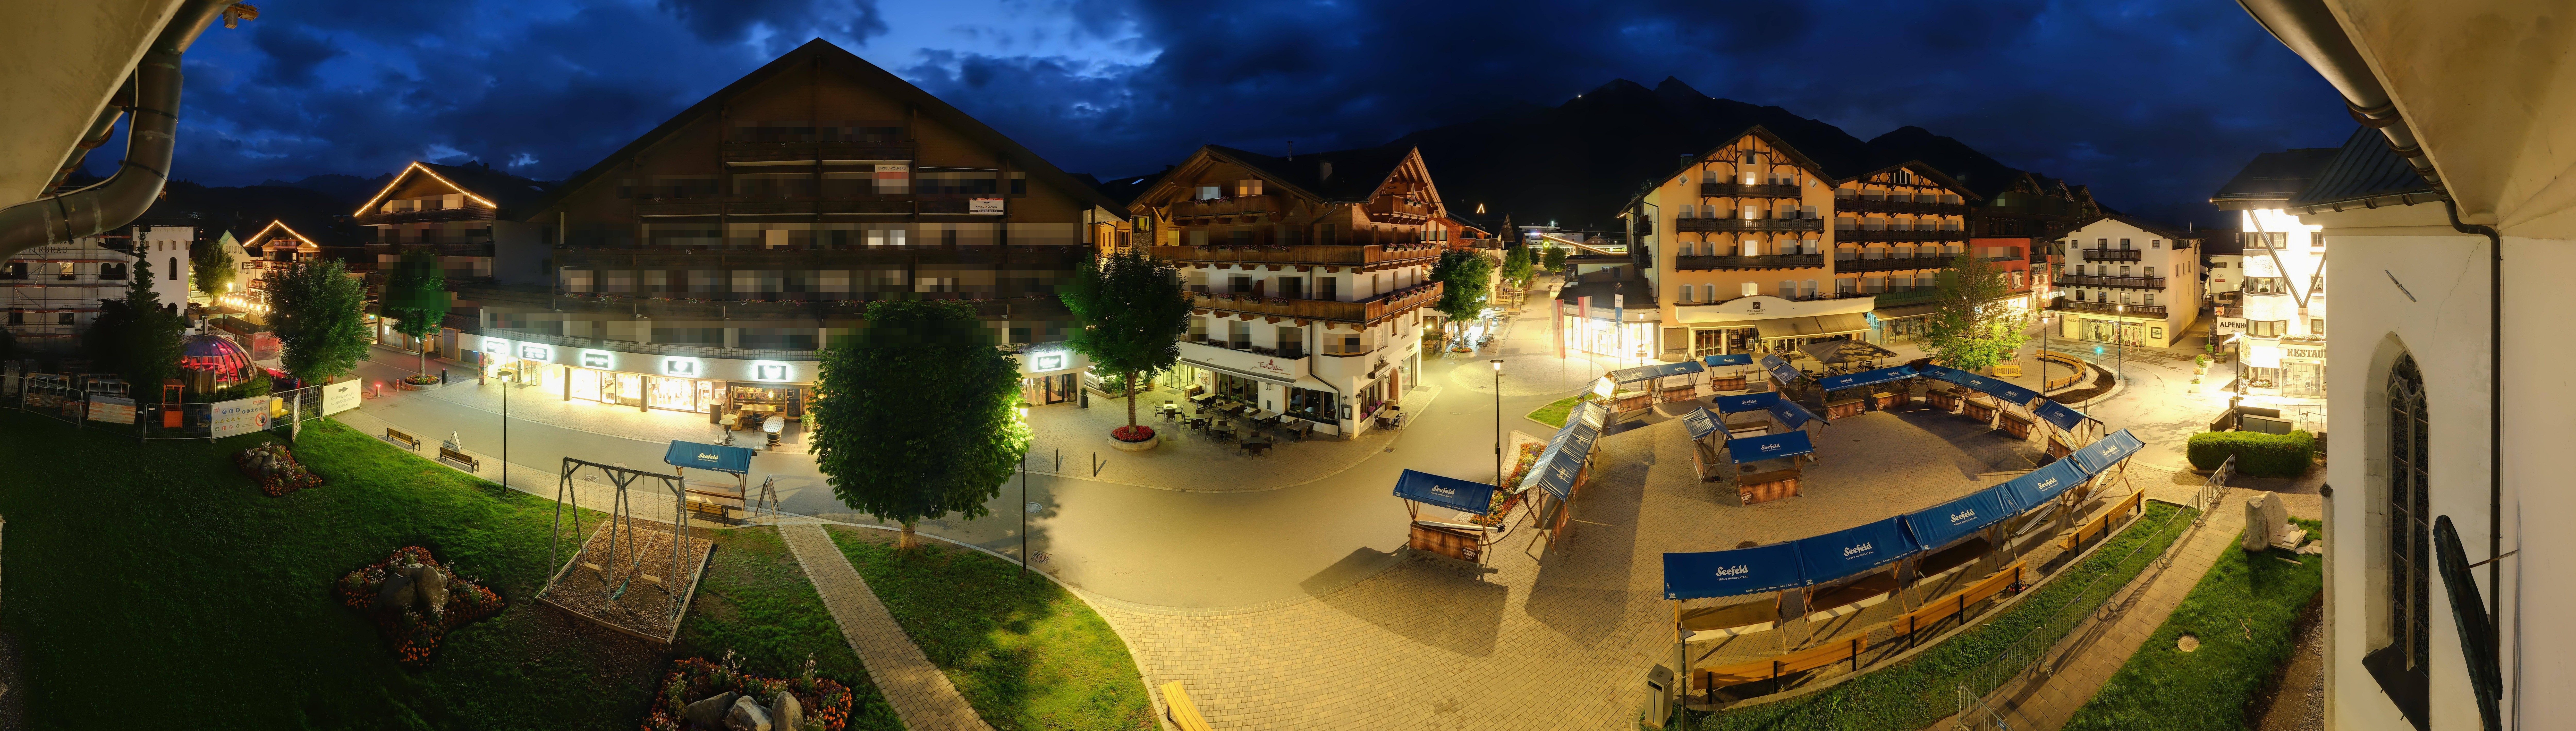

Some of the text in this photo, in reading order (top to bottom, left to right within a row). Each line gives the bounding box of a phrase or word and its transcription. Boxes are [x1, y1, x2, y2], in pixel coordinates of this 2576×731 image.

[1406, 343, 1414, 351] SAILER
[2287, 348, 2326, 358] RESTAU
[1375, 364, 1390, 377] RESTAURANT
[331, 397, 354, 405] KONGRESSZENTRUM
[2103, 445, 2118, 455] Seefeld
[2038, 477, 2057, 489] Seefeld
[1432, 485, 1455, 495] Seefeld
[1951, 508, 1975, 522] Seefeld
[1843, 542, 1872, 556] Seefeld
[1716, 564, 1749, 576] Seefeld
